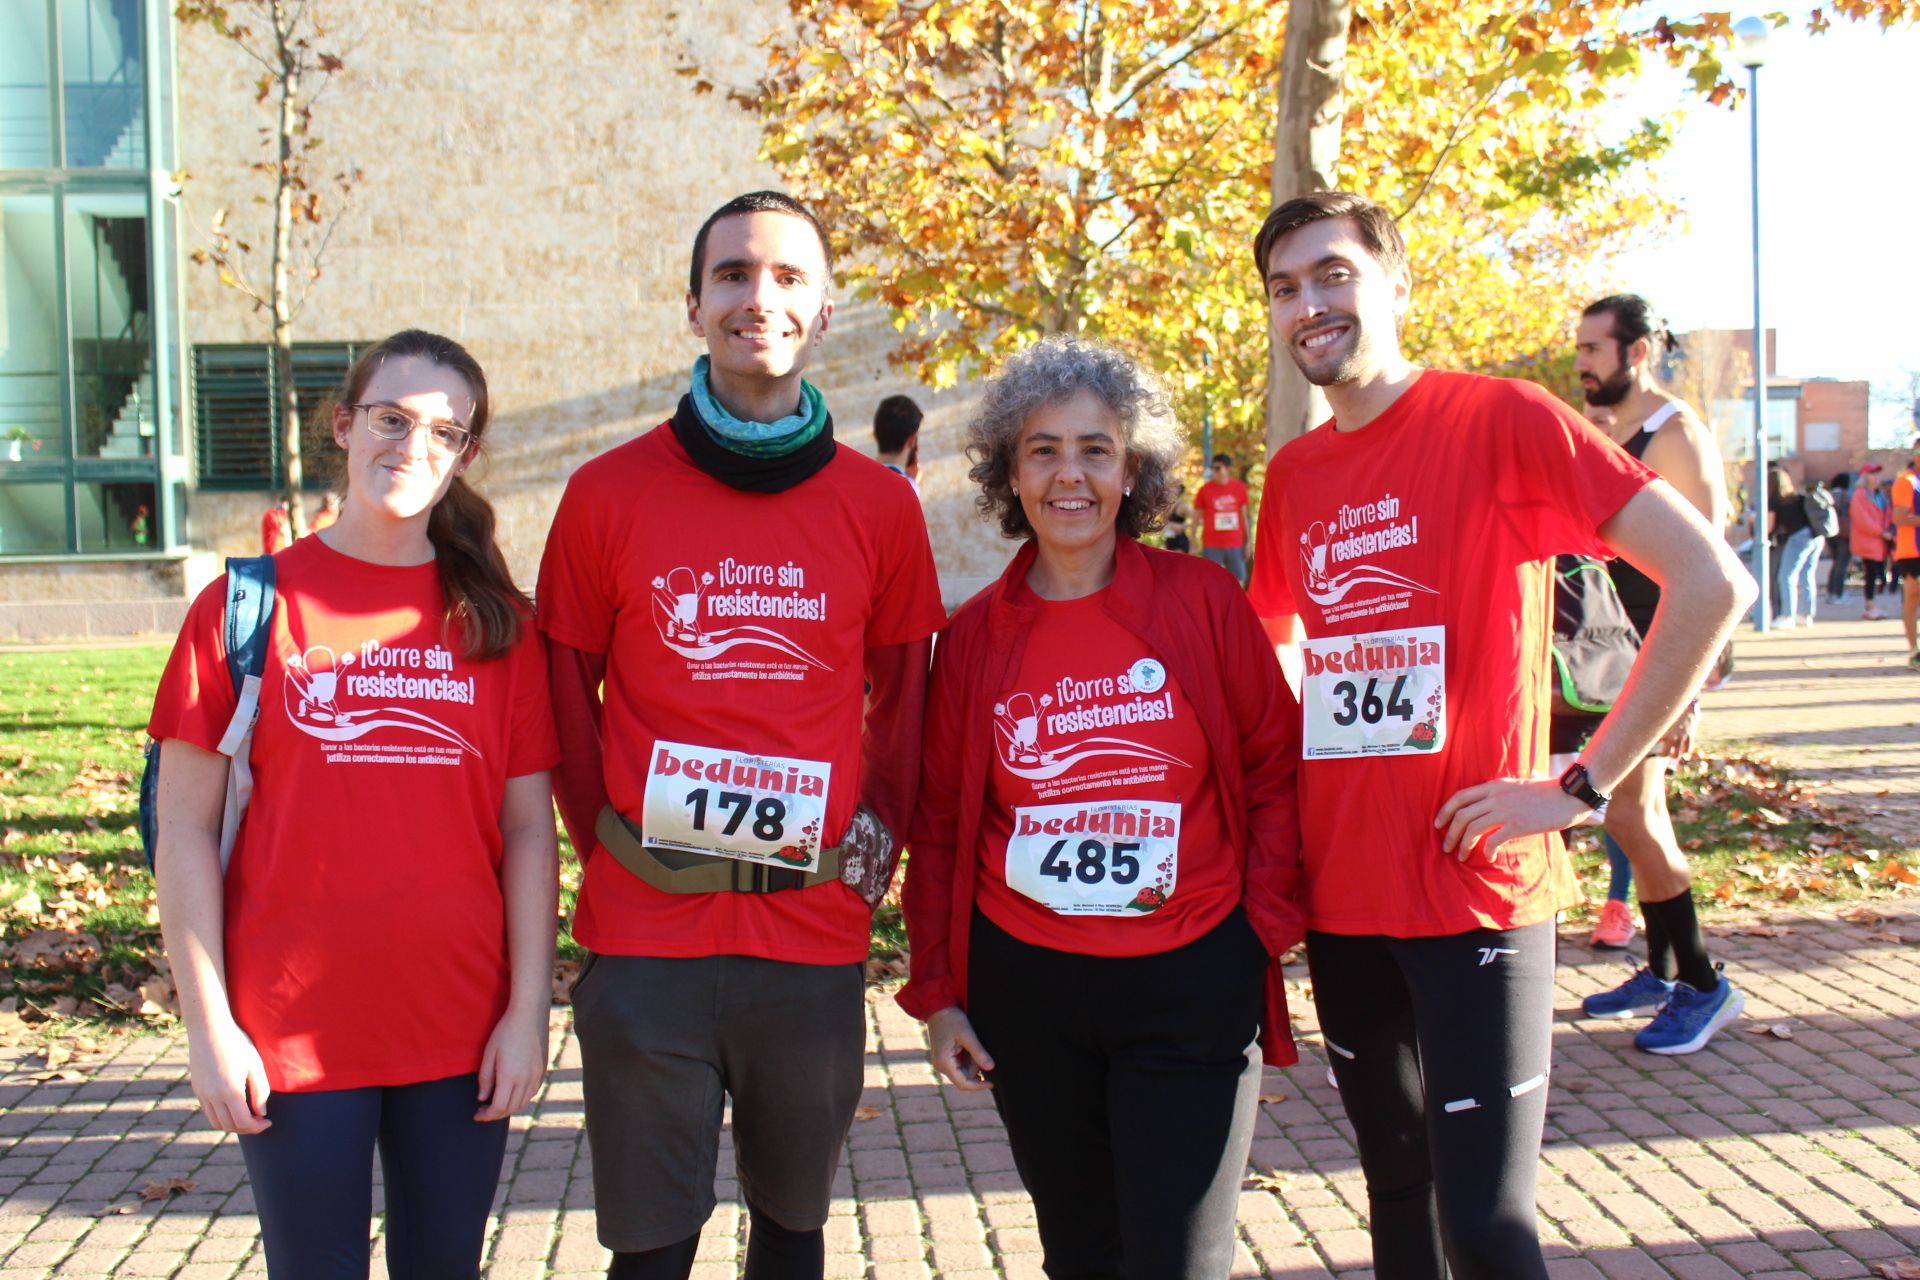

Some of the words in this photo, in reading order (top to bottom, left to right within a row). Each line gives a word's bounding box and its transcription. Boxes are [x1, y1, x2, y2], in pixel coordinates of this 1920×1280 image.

[1338, 503, 1376, 535] ¡Corre
[1377, 493, 1400, 521] sin
[1331, 515, 1418, 563] resistencias!
[719, 557, 774, 588] ¡Corre
[778, 561, 804, 588] sin
[707, 588, 826, 622] resistencias!
[361, 639, 420, 669] ¡Corre
[425, 644, 453, 671] sin
[1303, 637, 1441, 677] bedunia
[347, 670, 475, 705] resistencias!
[1056, 676, 1114, 707] ¡Corre
[1117, 668, 1141, 694] si
[1333, 675, 1414, 727] 364
[1046, 691, 1174, 736] resistencias!
[654, 748, 824, 798] bedunia
[685, 788, 786, 842] 178
[1017, 808, 1175, 838] bedunia
[1040, 839, 1140, 885] 485
